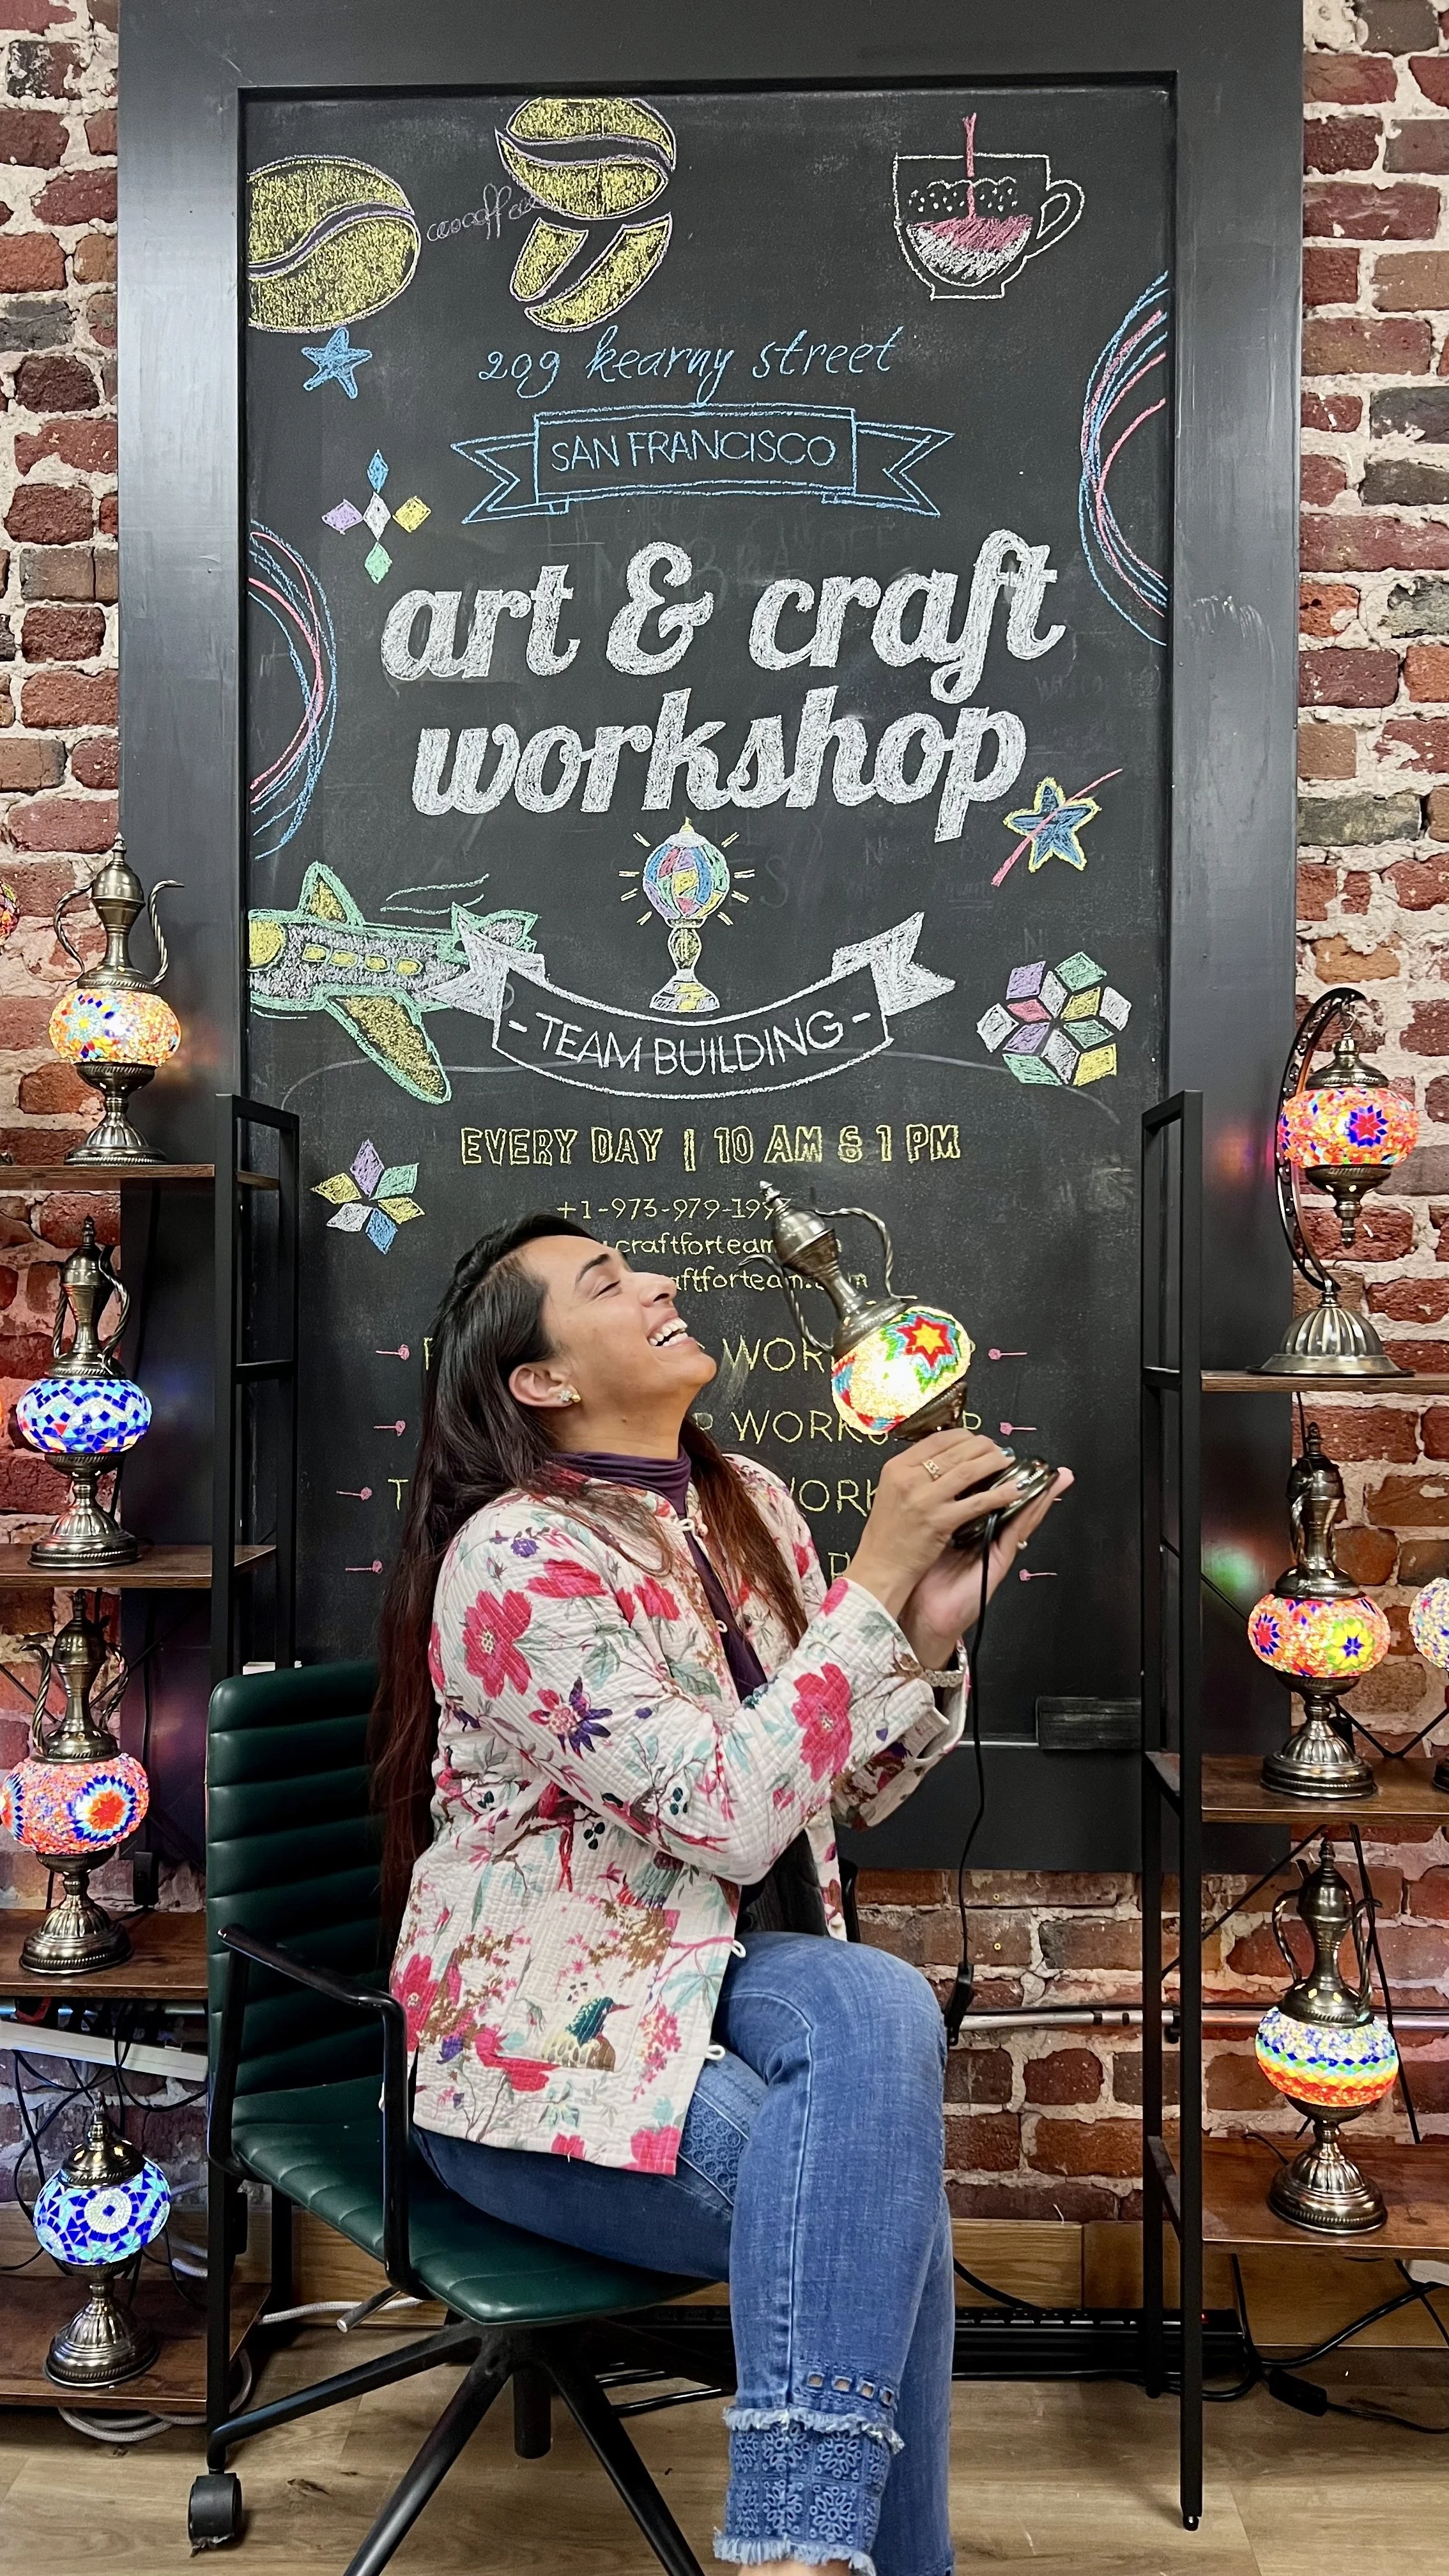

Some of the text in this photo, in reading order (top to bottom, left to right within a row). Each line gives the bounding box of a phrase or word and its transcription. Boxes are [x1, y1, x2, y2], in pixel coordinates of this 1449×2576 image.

[479, 325, 904, 405] 209 kearny street
[552, 429, 836, 471] SAN FRANCISCO
[381, 529, 1066, 704] art & craft
[411, 686, 1026, 843] workshop
[535, 1013, 643, 1071] TEAM
[654, 1009, 844, 1076] BUILDING
[461, 1127, 578, 1166] EVERY
[591, 1127, 663, 1165] DAY
[714, 1126, 753, 1163] 10
[763, 1124, 822, 1163] AM
[876, 1125, 892, 1162] 1
[906, 1124, 960, 1163] PM
